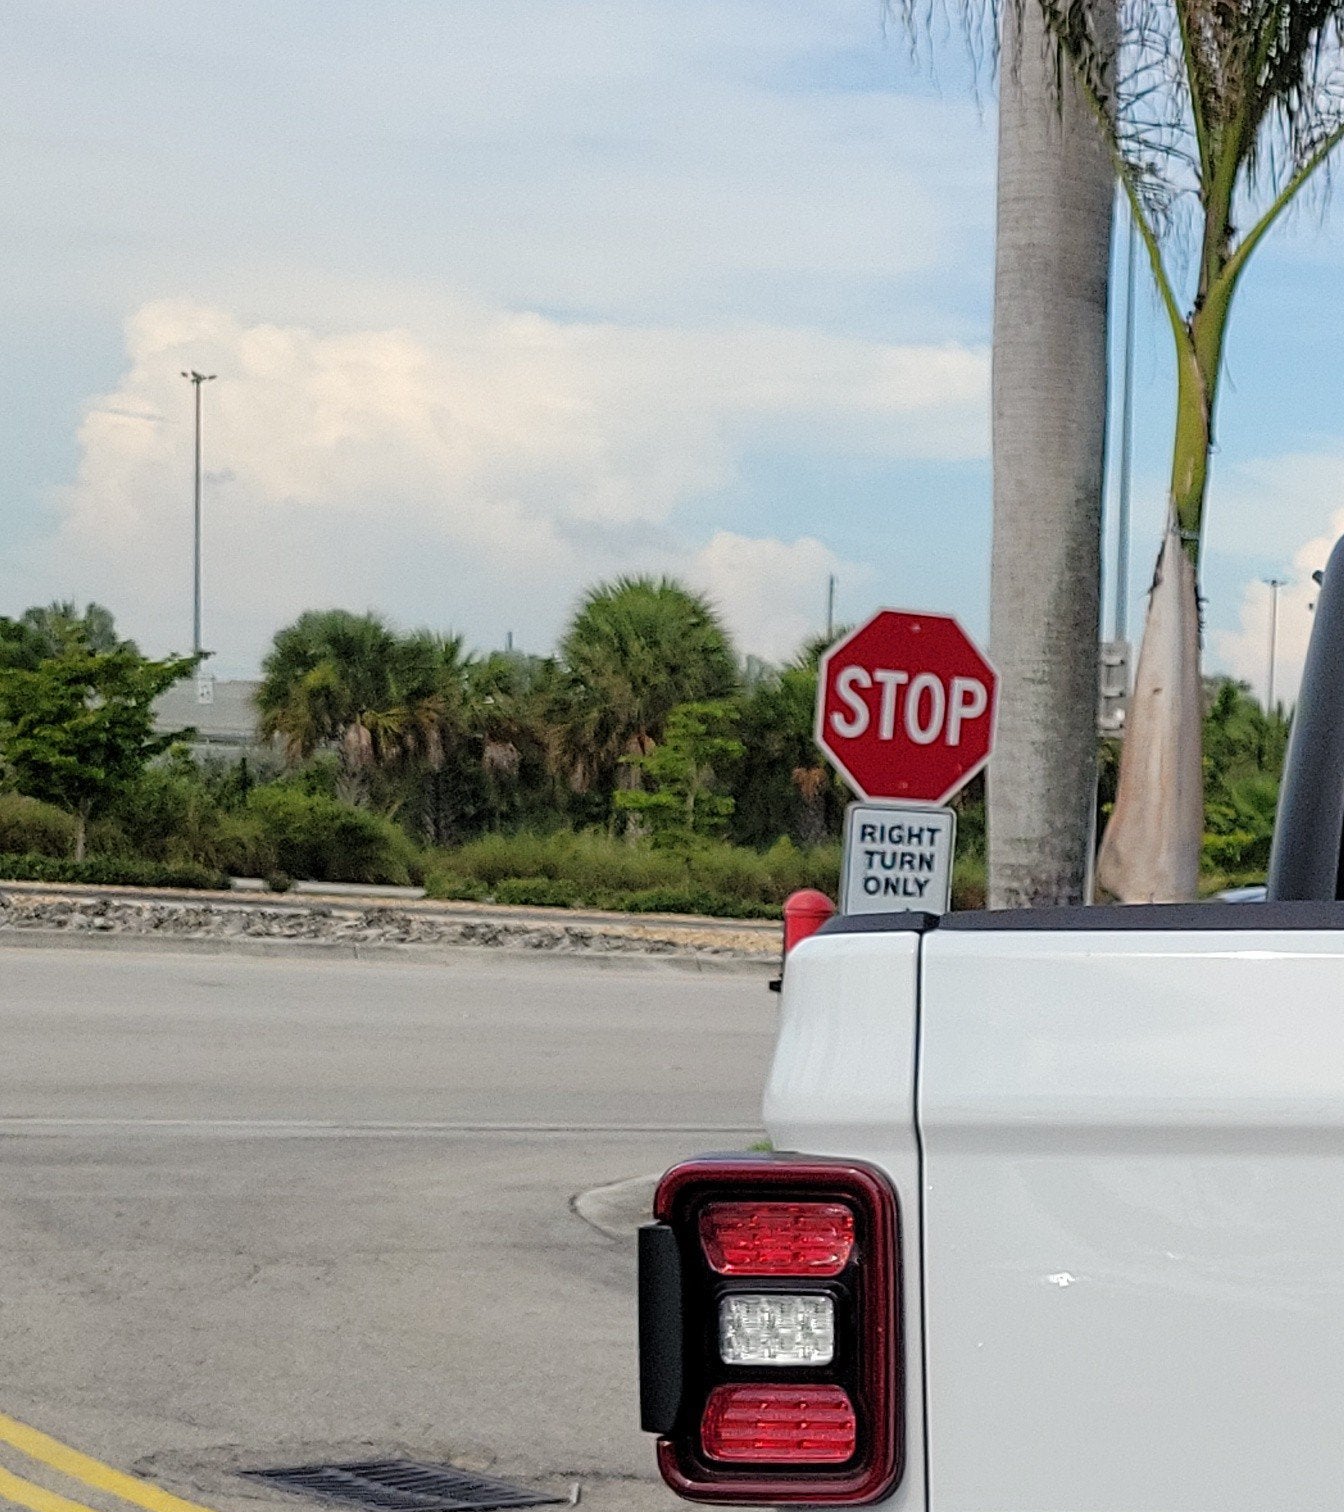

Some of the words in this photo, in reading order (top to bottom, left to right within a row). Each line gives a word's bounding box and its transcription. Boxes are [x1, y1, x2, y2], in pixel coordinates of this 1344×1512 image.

[830, 665, 988, 746] STOP
[861, 823, 941, 846] RIGHT
[864, 850, 934, 872] TURN
[863, 876, 929, 898] ONLY
